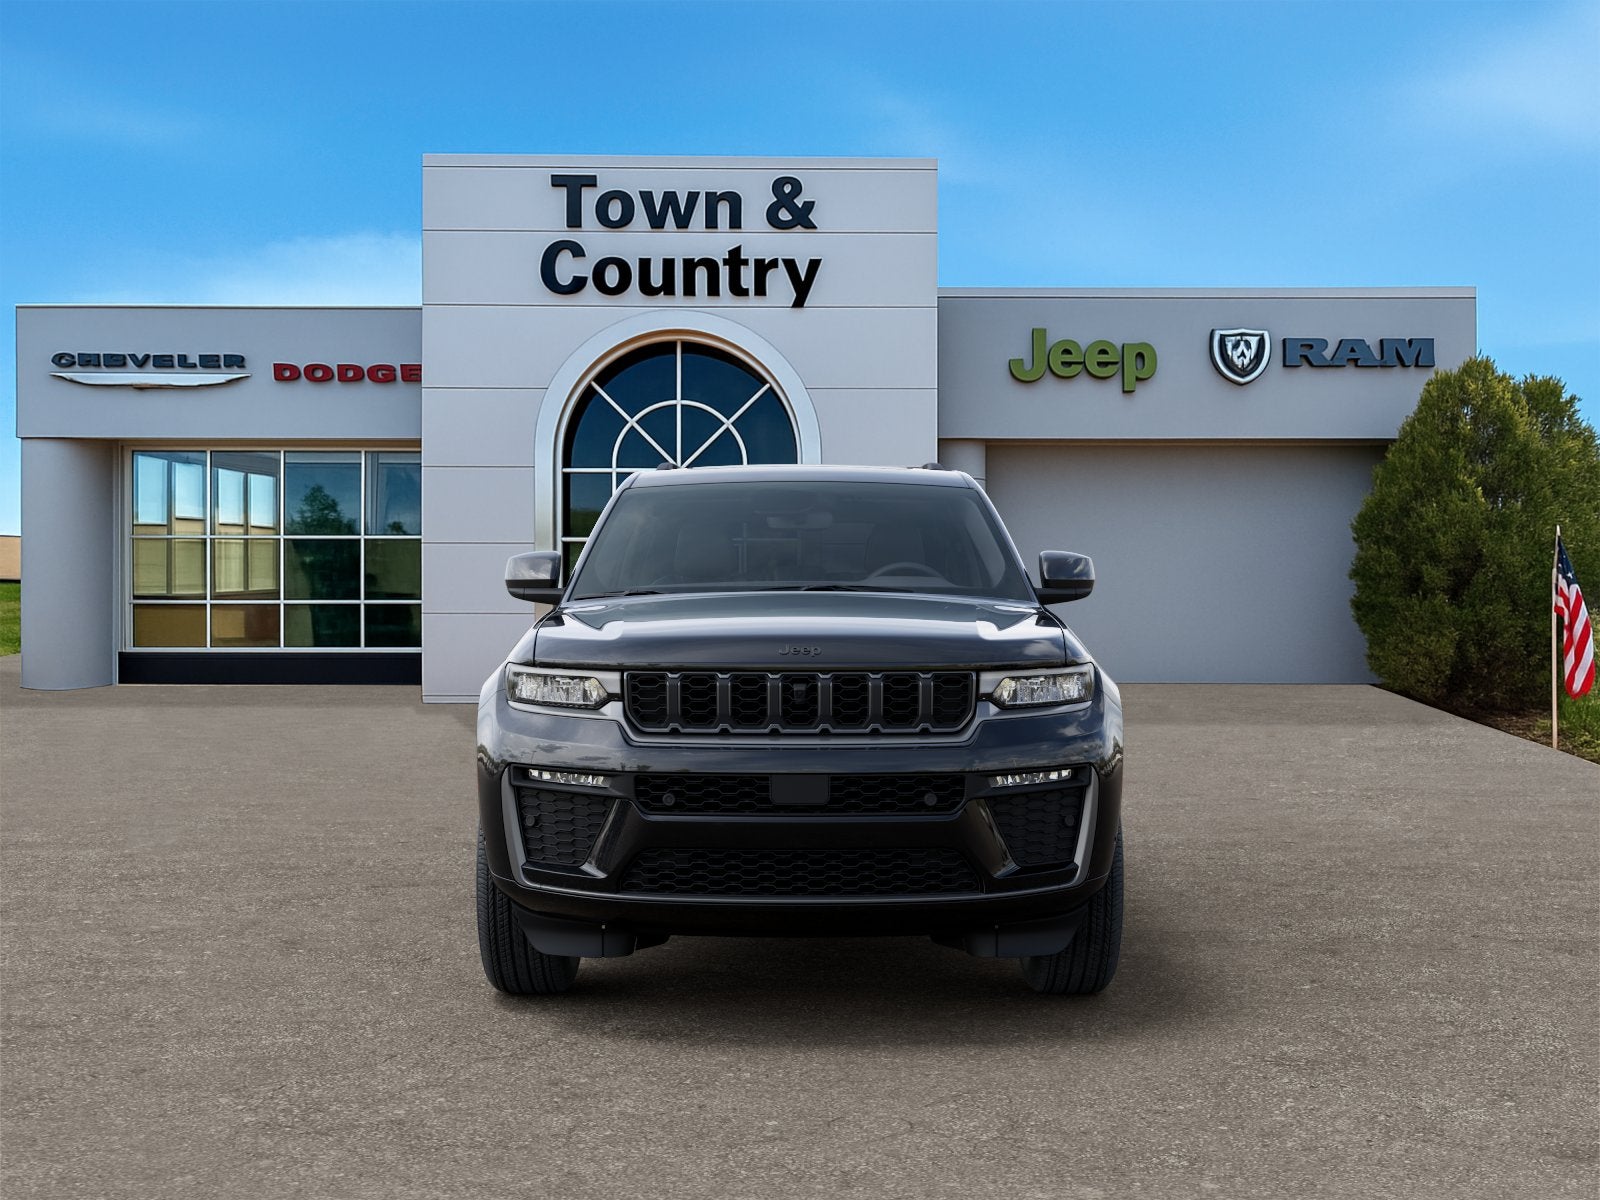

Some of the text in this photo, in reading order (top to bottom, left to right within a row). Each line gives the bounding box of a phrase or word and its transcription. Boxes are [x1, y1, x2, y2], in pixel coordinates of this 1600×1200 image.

[550, 174, 818, 229] Town &
[540, 239, 822, 308] Country
[273, 363, 422, 383] DODGE
[1009, 328, 1157, 393] Jeep
[1283, 338, 1435, 367] RAM
[779, 643, 822, 658] Jeep
